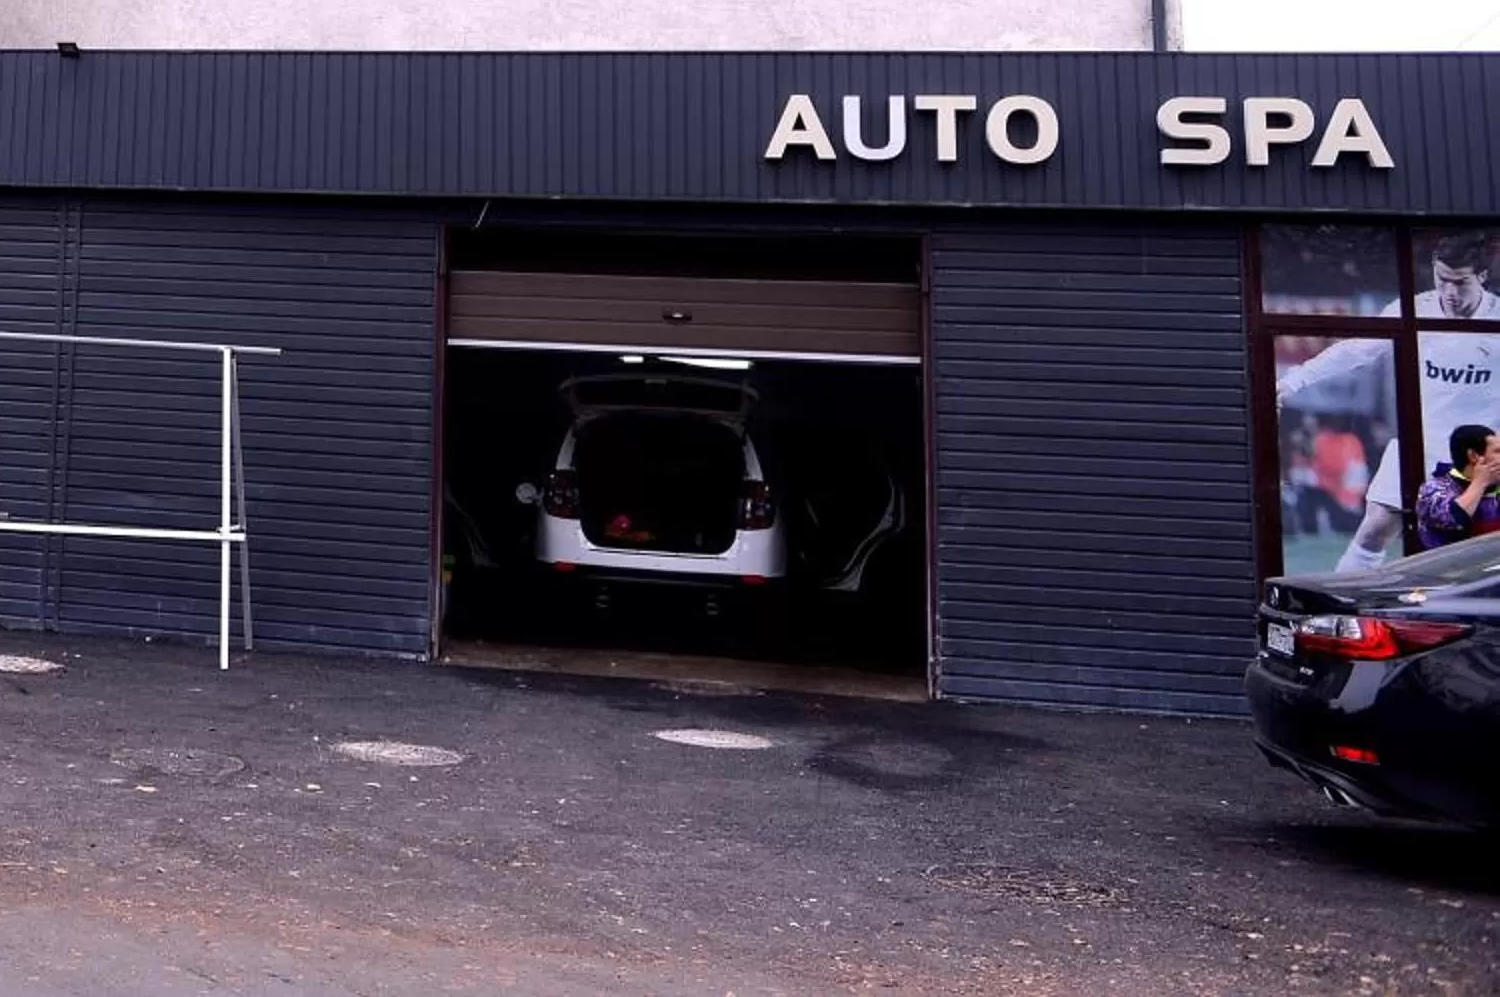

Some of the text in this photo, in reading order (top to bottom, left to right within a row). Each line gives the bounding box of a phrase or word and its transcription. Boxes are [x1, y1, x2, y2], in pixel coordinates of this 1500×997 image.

[764, 94, 1395, 168] AUTO SPA
[1425, 359, 1492, 384] bwin
